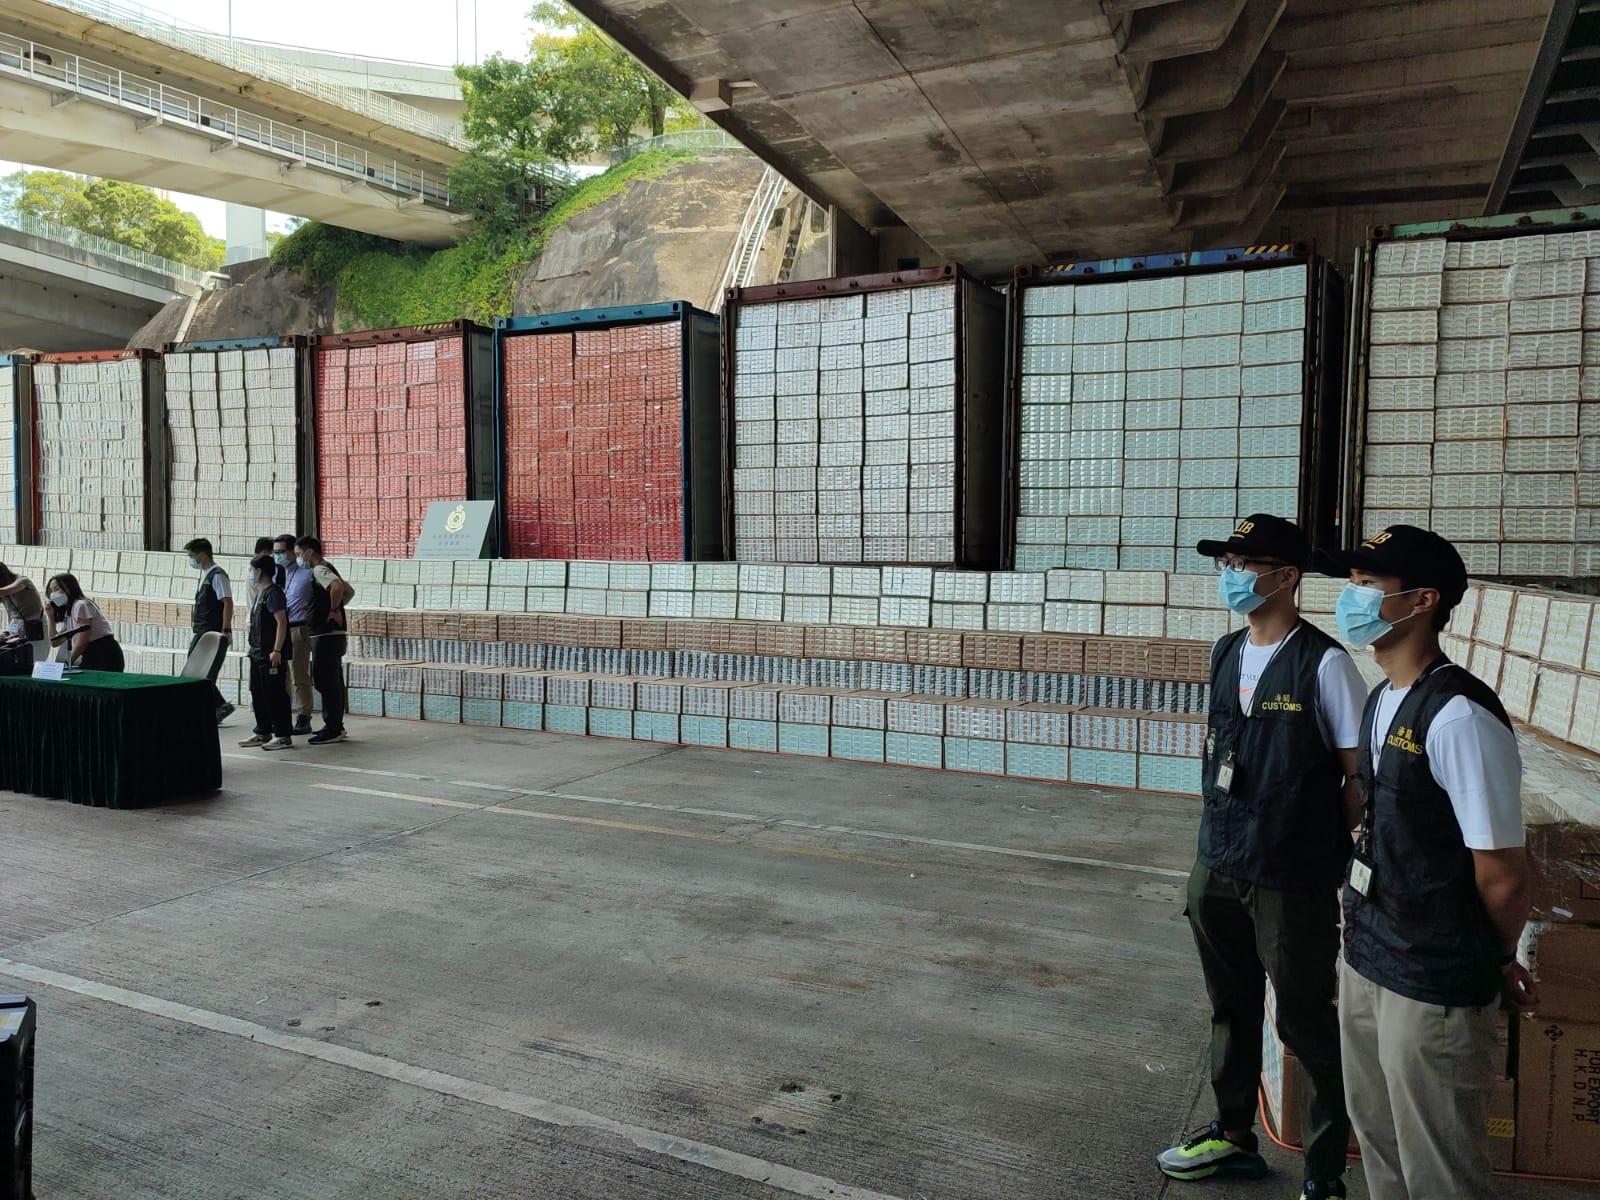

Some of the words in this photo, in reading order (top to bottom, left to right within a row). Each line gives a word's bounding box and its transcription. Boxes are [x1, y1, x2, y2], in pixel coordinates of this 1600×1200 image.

[1261, 702, 1303, 712] CUSTOMS
[1387, 734, 1424, 755] CUSTOMS
[1588, 1049, 1600, 1074] FOR
[1586, 1077, 1600, 1125] EXPORT
